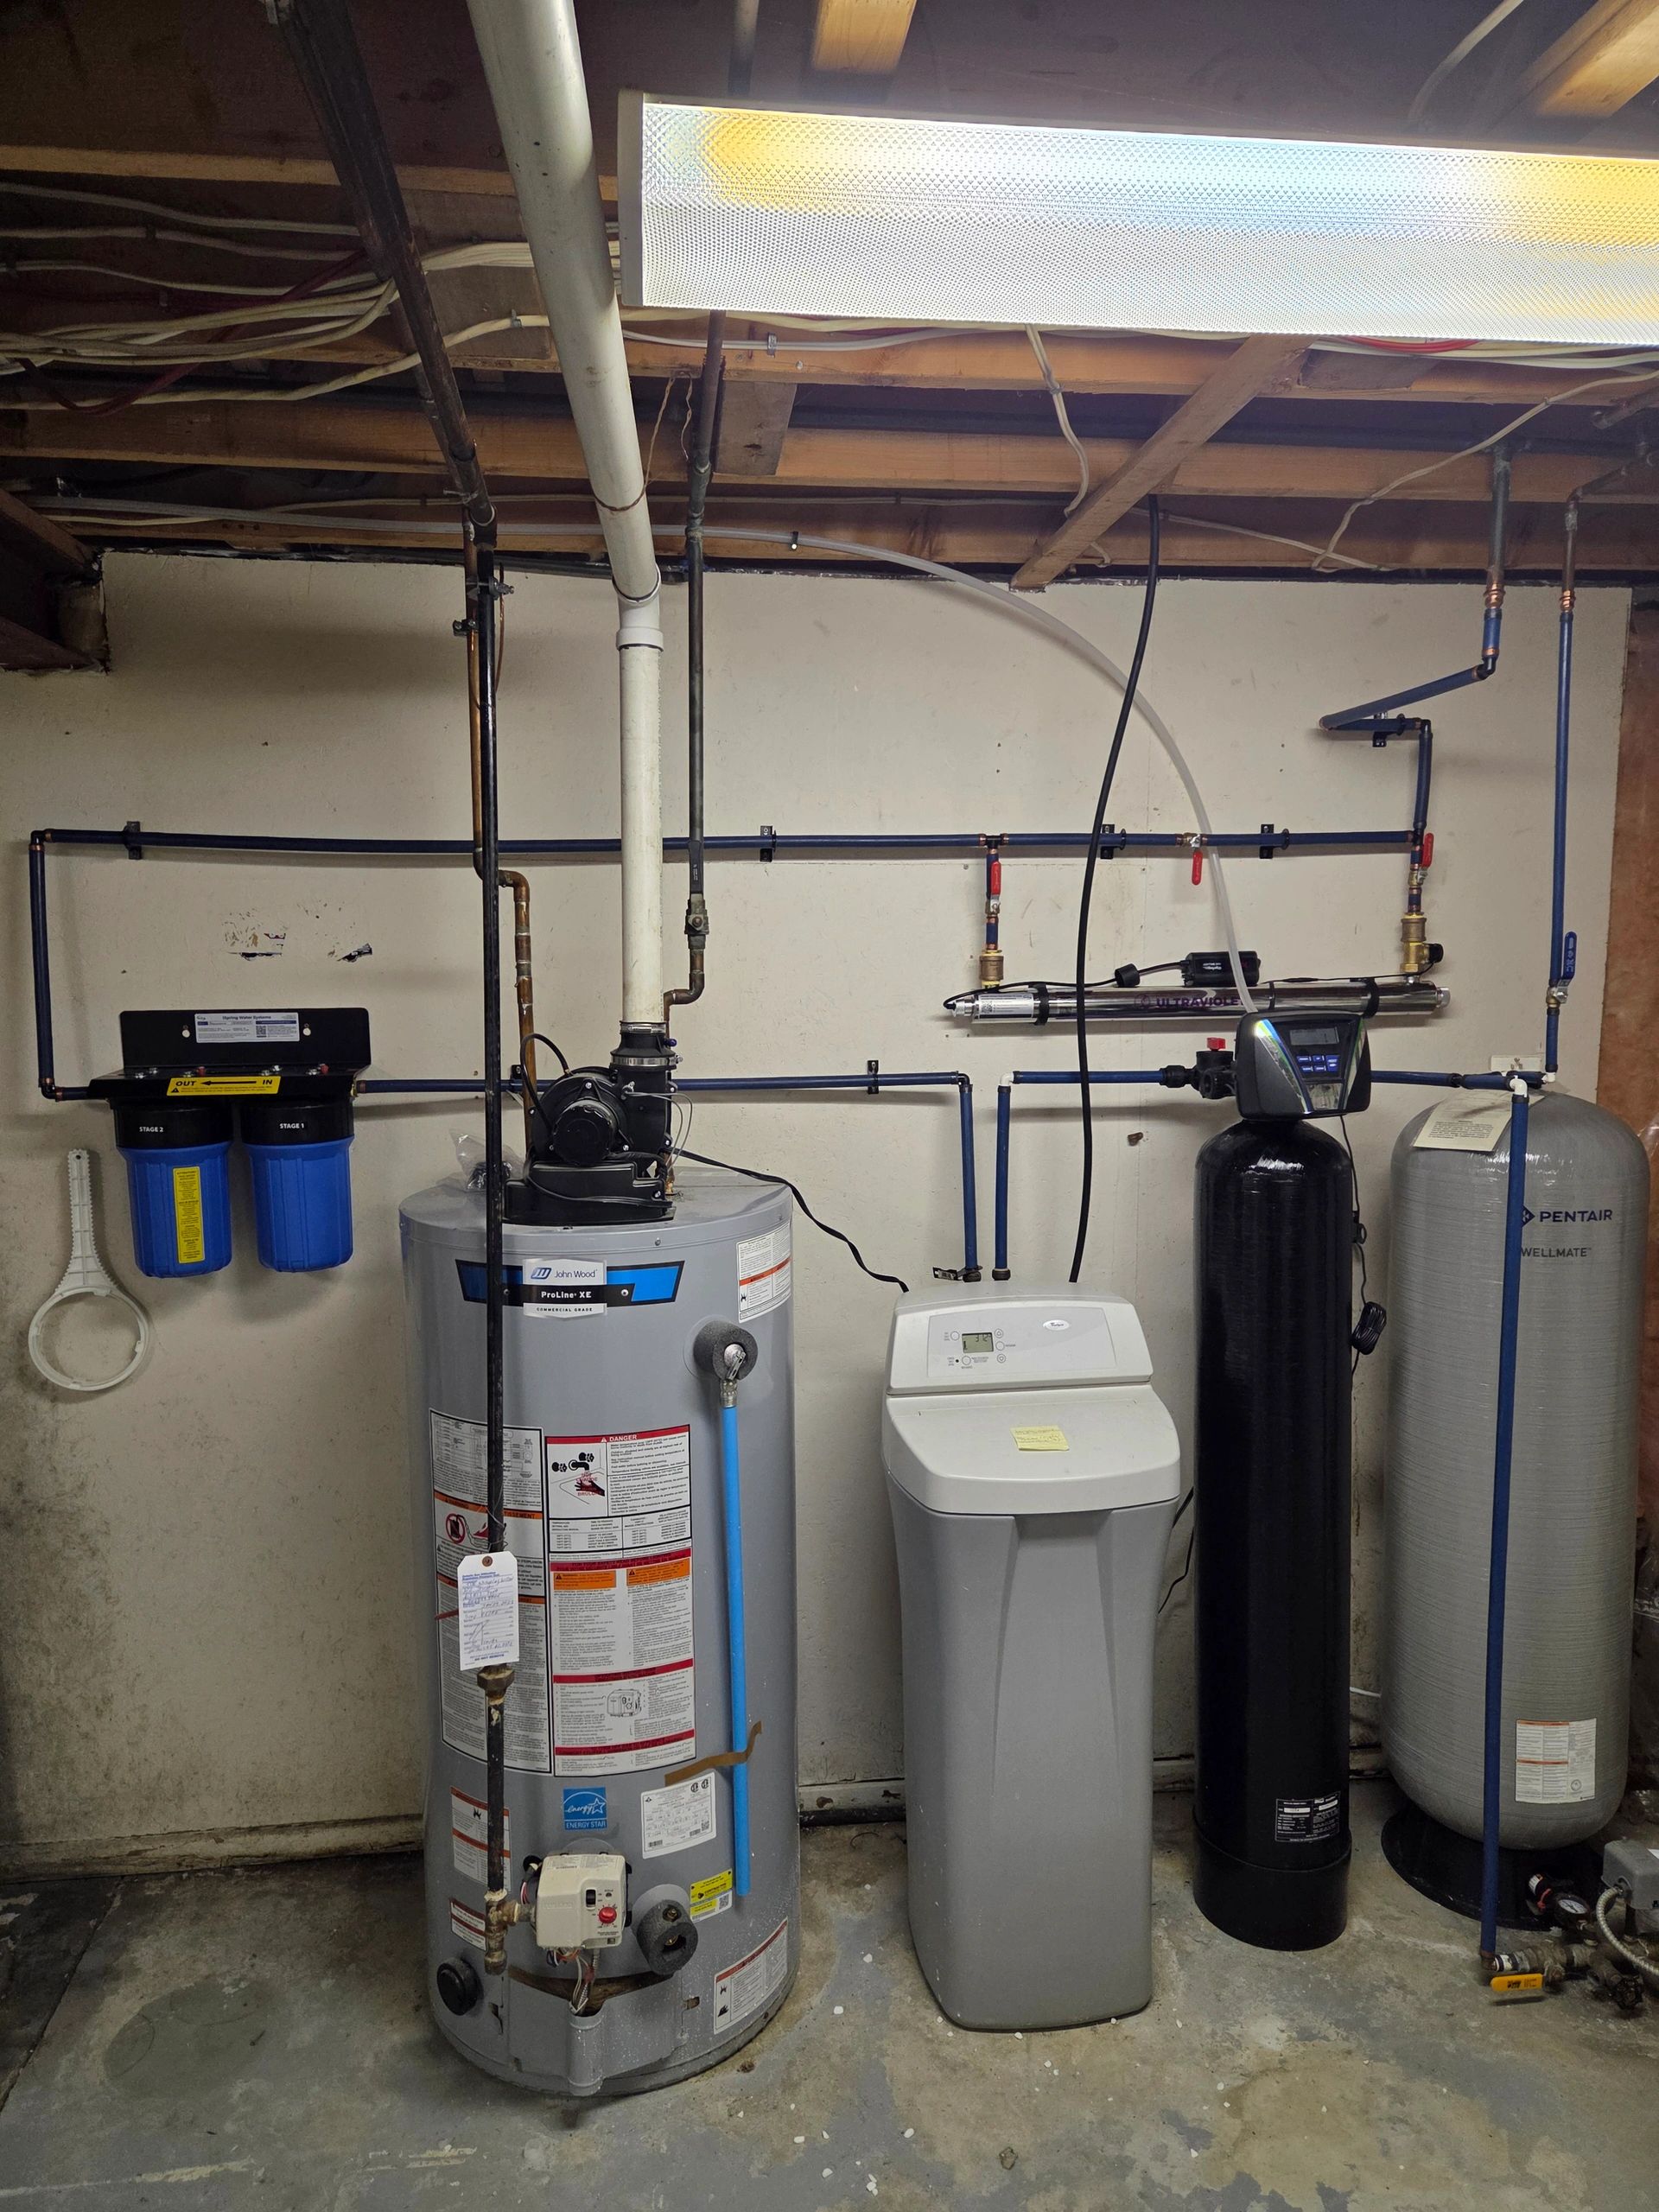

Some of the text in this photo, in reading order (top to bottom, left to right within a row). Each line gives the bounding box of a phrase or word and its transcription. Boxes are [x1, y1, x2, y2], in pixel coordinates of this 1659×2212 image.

[1156, 996, 1244, 1007] ULTRAVIOLE
[1540, 1209, 1613, 1223] PENTAIR
[554, 1269, 596, 1279] John Wood
[566, 1820, 606, 1829] ENERGY STAR
